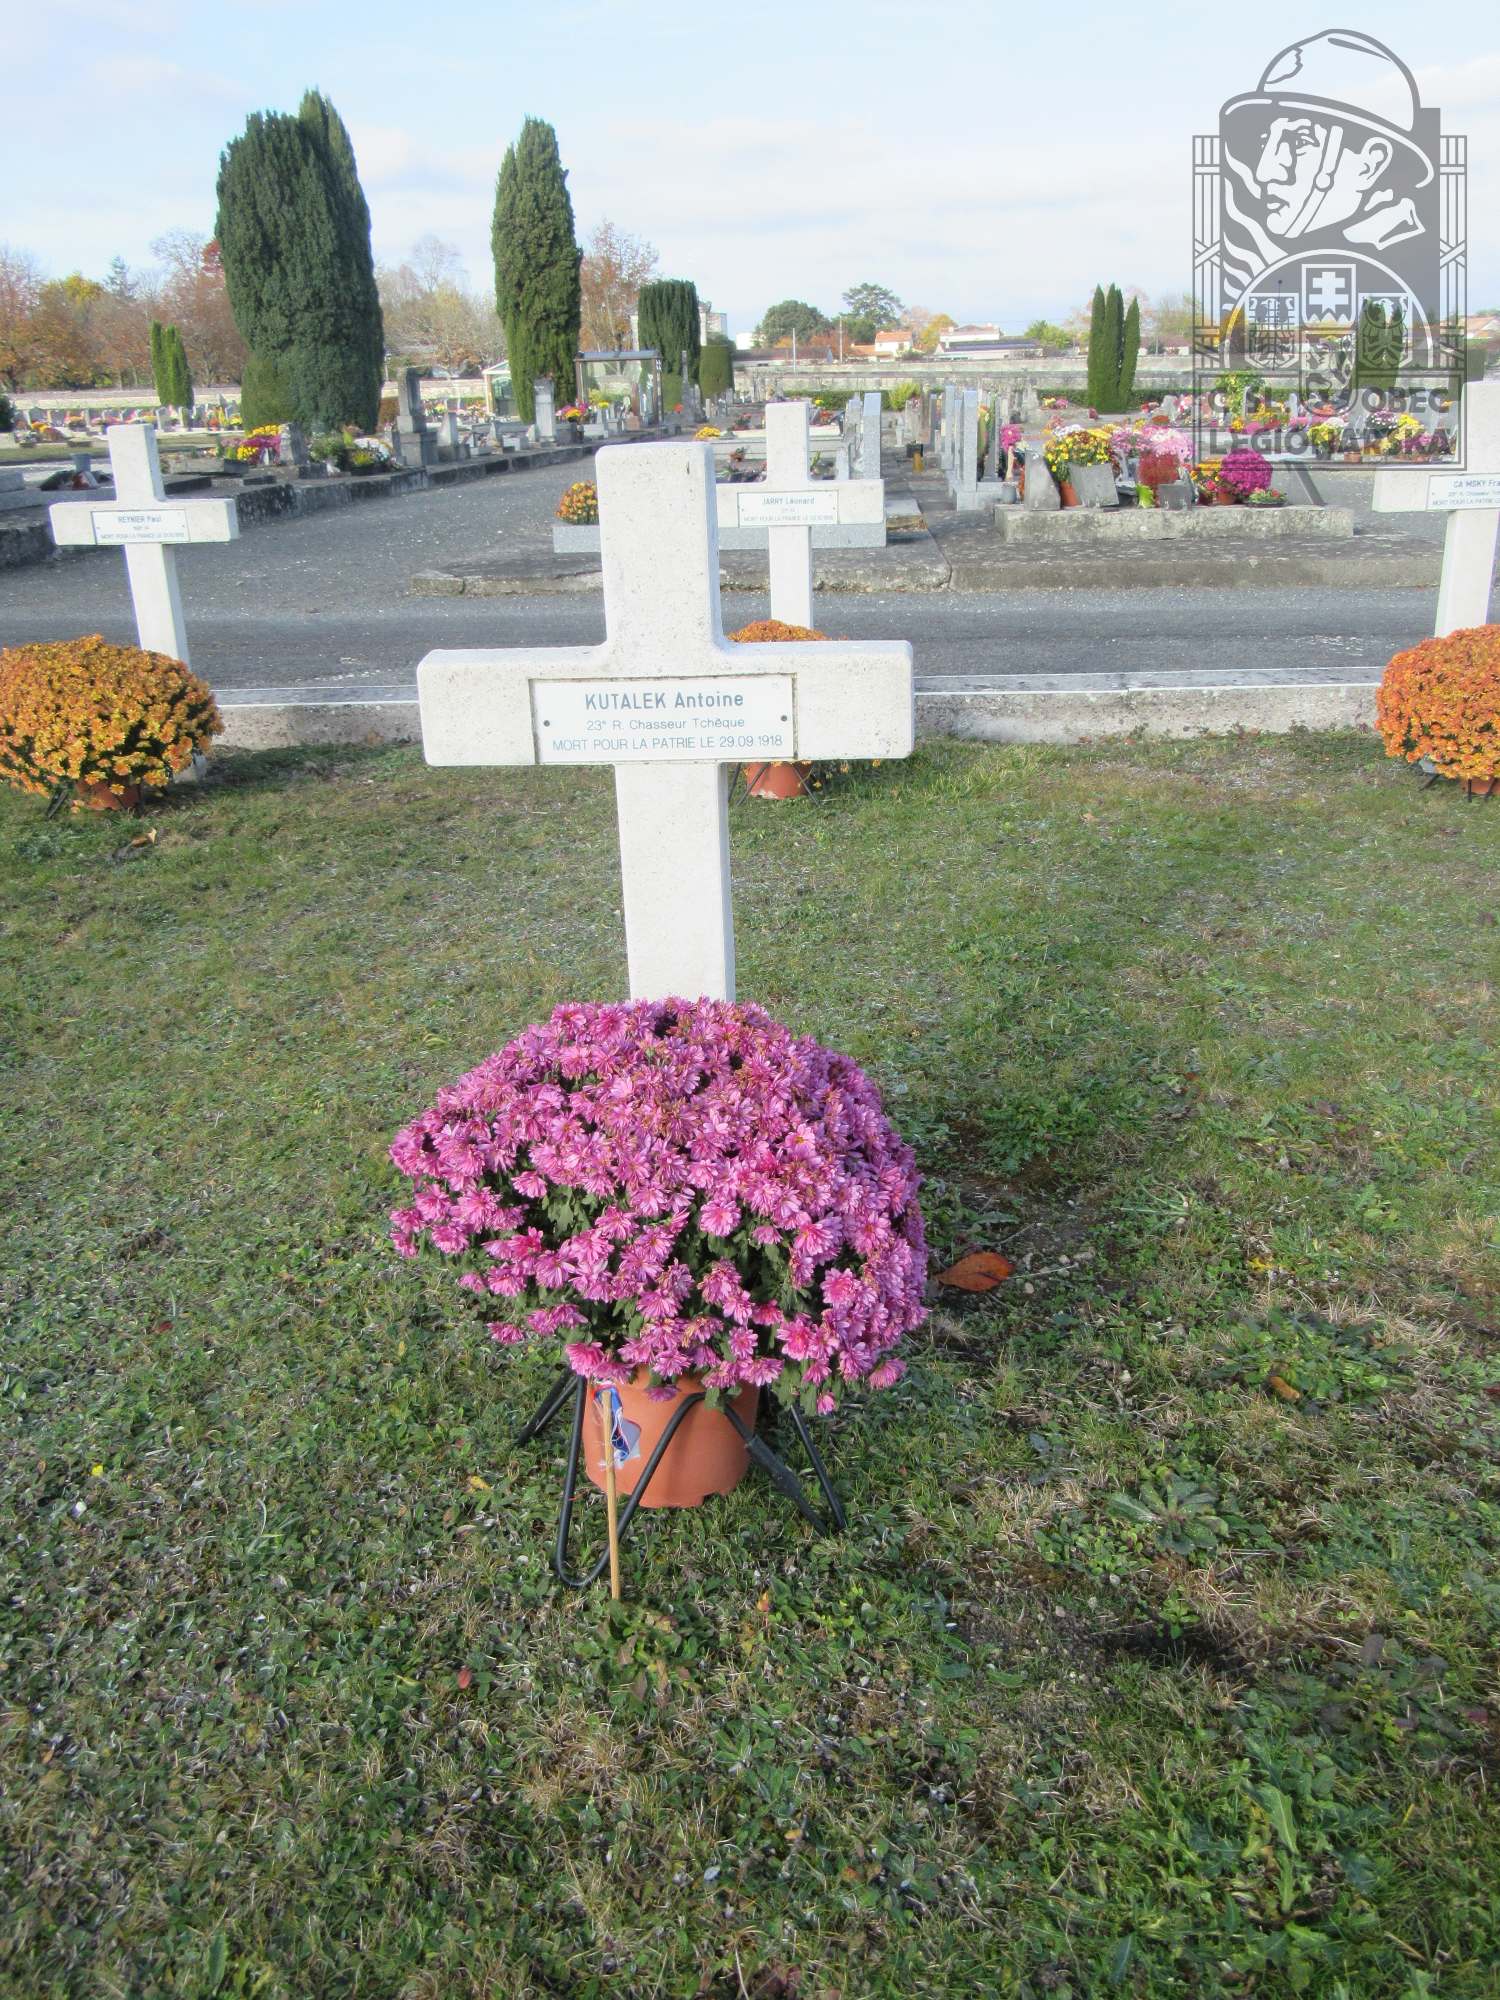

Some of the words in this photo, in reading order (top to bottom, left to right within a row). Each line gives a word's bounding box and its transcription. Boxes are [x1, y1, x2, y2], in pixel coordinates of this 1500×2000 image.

[585, 692, 667, 711] KUTALEK
[674, 691, 744, 709] Antoine
[630, 718, 687, 731] Chasseur
[552, 739, 587, 751] MORT
[593, 738, 629, 751] POUR
[632, 737, 648, 750] LA
[652, 736, 697, 750] PATRIE
[700, 735, 716, 749] LE
